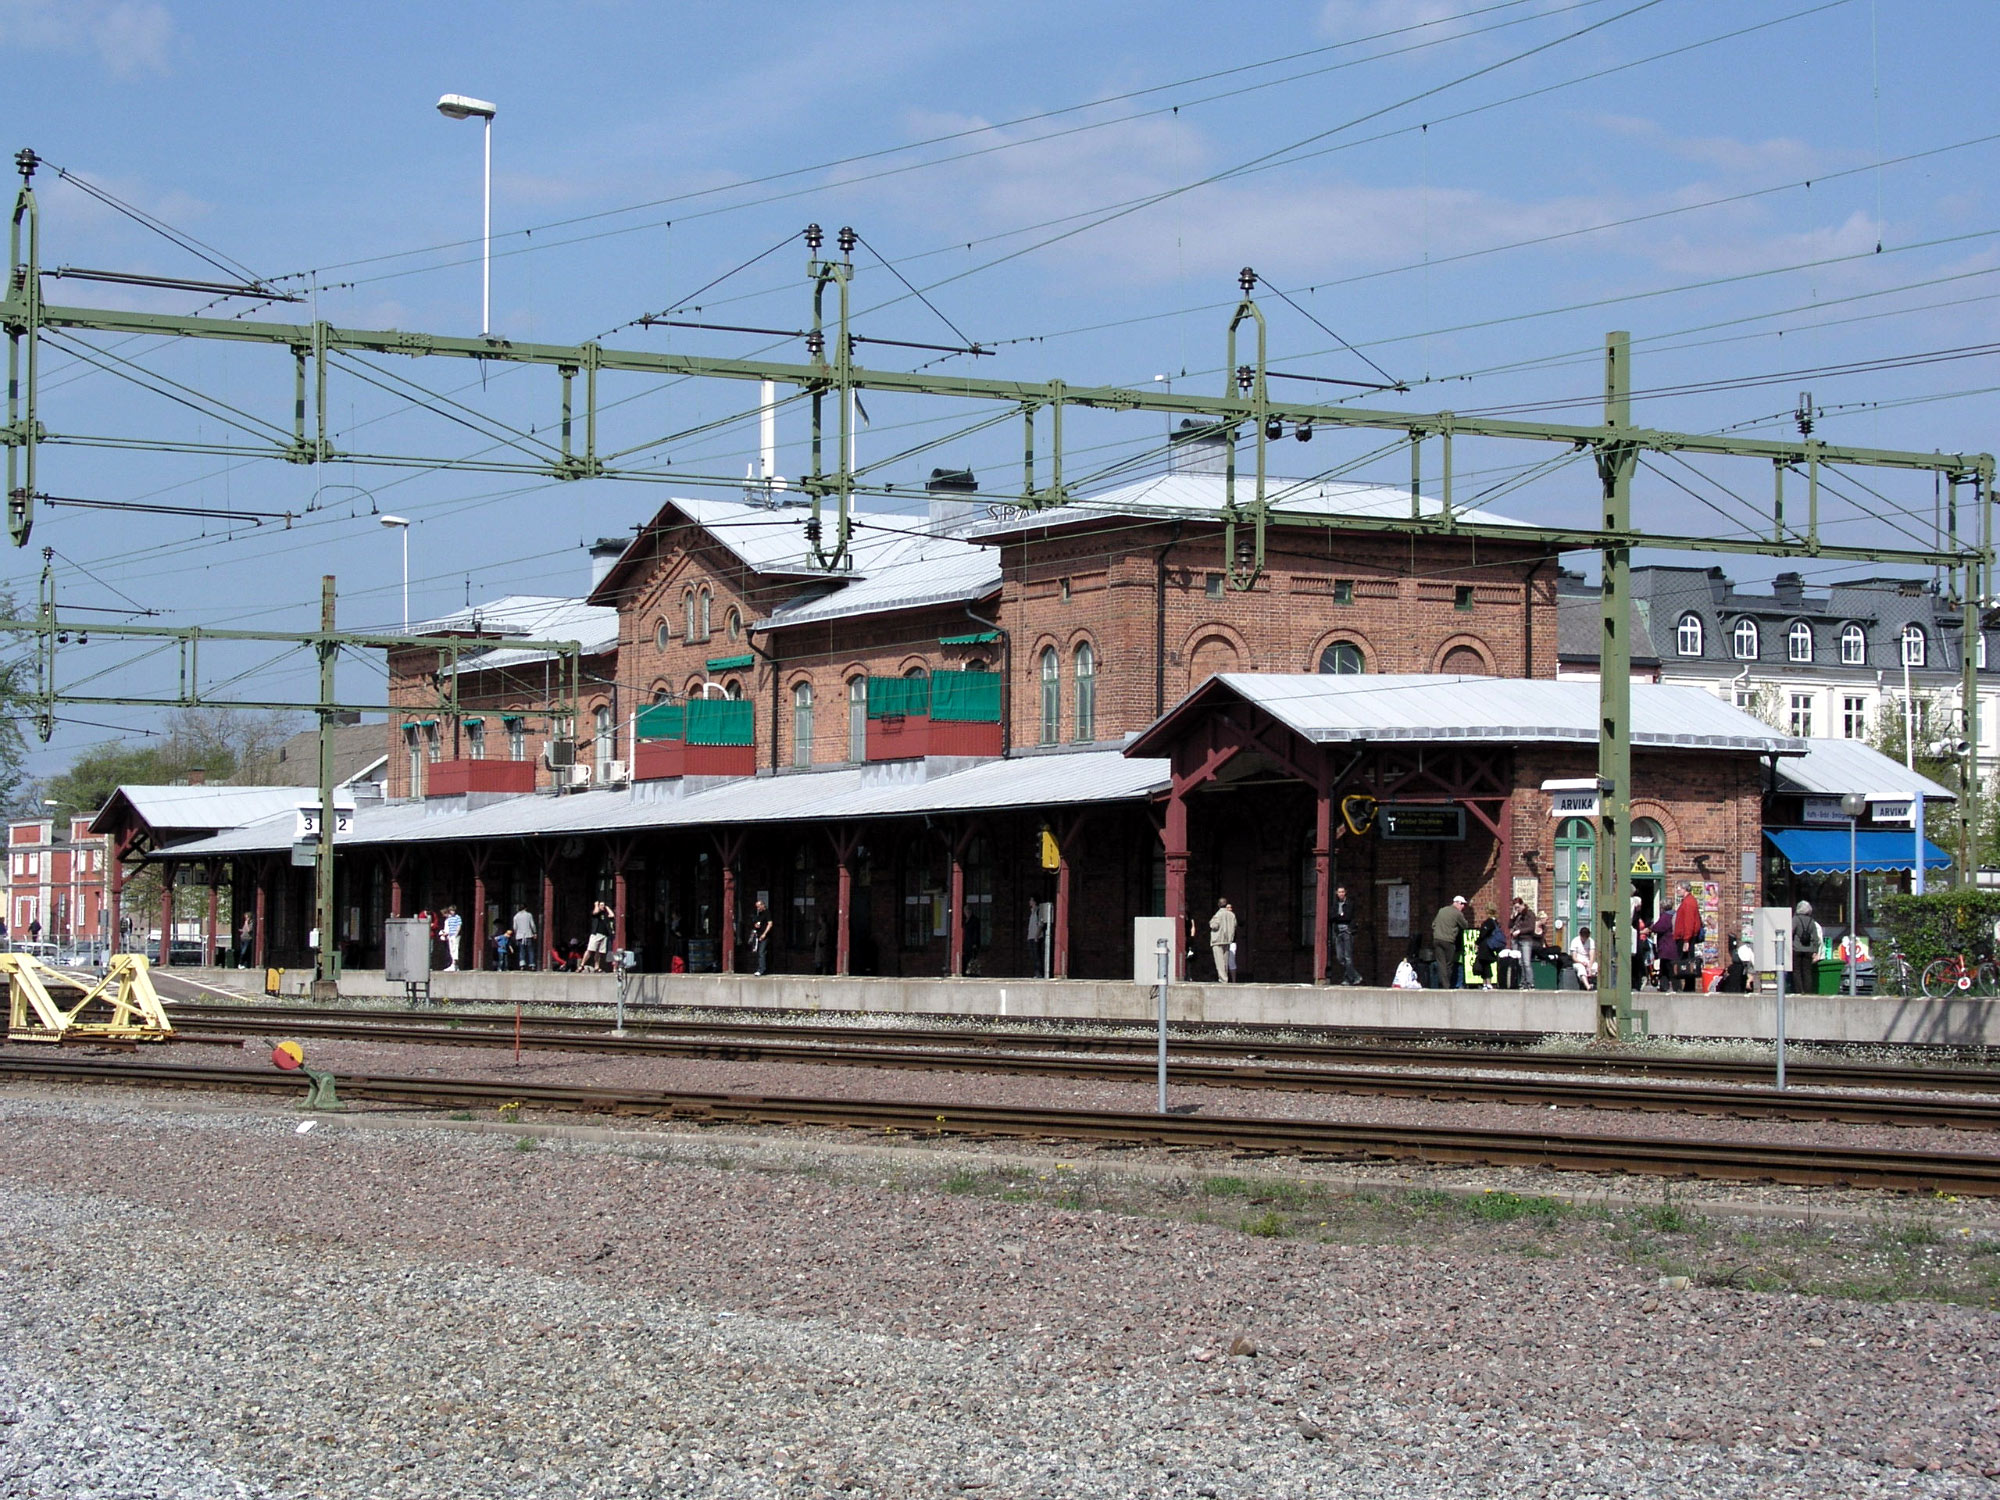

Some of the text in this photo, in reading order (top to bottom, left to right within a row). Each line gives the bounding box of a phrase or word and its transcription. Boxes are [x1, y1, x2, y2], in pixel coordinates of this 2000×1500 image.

[1560, 798, 1593, 811] ARVIKA
[1879, 807, 1908, 817] ARVIKA
[304, 818, 313, 831] 3
[338, 818, 347, 831] 2
[1389, 821, 1395, 831] 1
